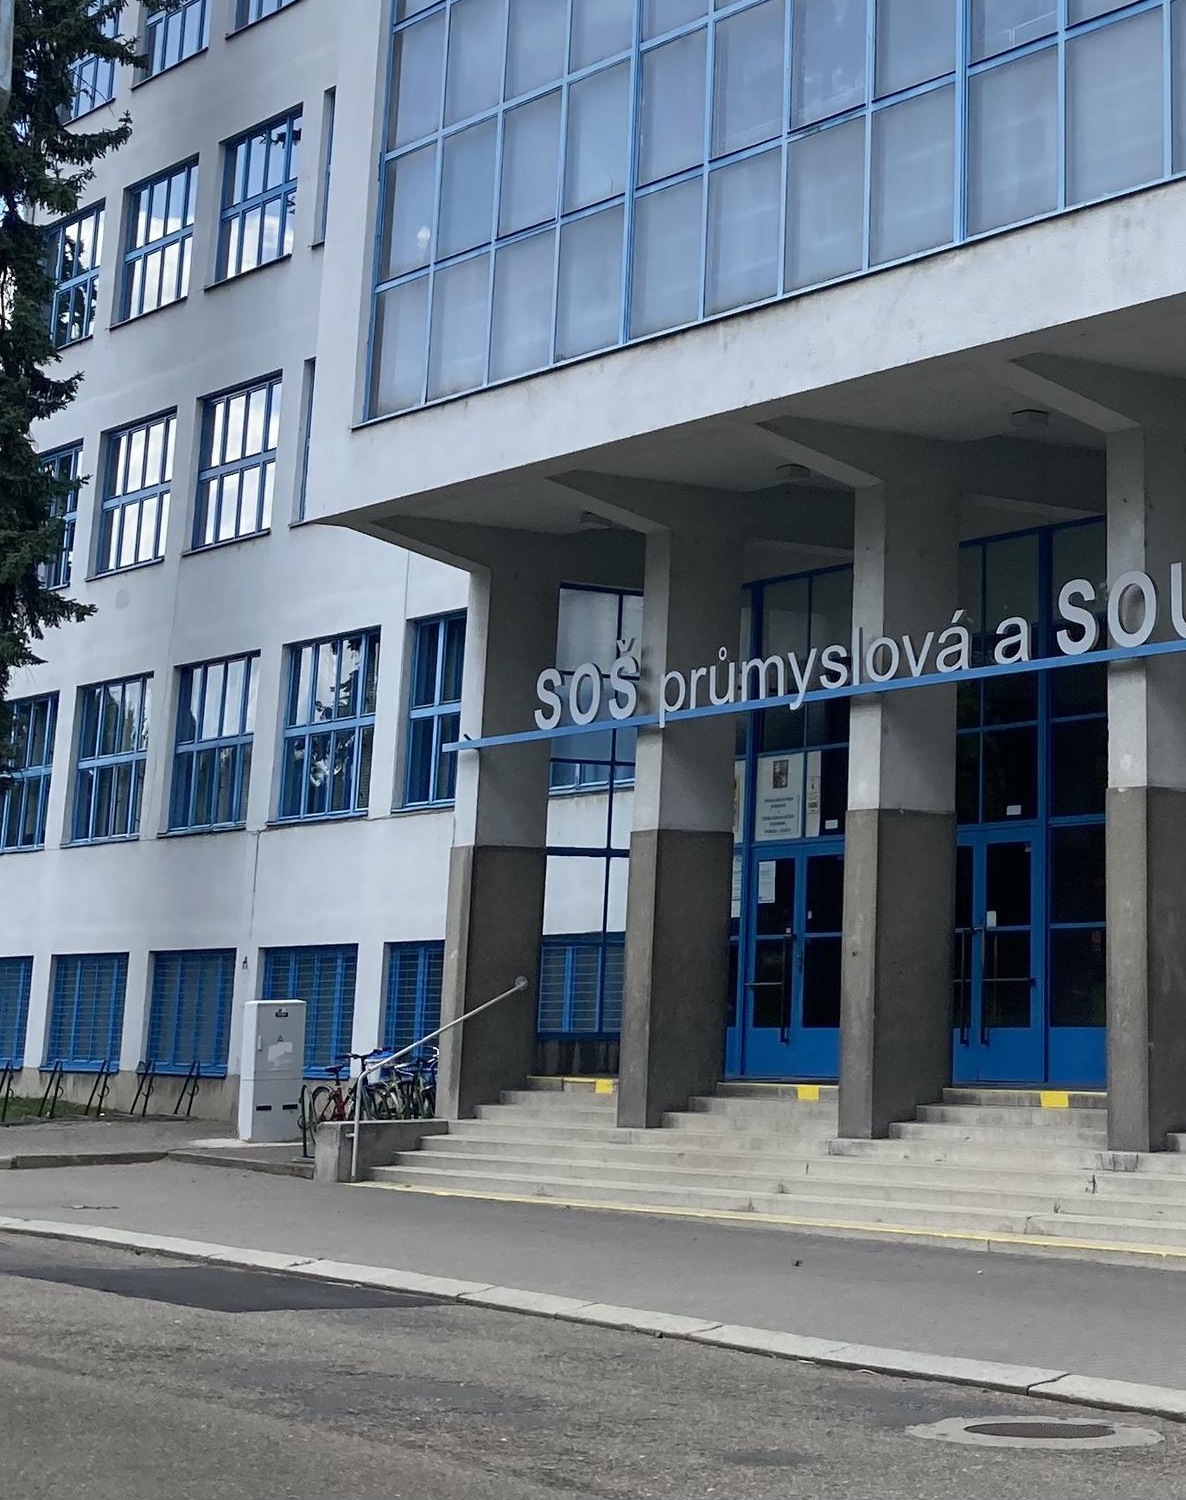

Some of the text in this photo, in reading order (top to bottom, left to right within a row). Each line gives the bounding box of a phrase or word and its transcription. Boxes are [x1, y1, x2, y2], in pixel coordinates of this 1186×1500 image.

[534, 638, 638, 731] SOŠ
[658, 609, 971, 729] průmyslová
[994, 615, 1032, 666] a
